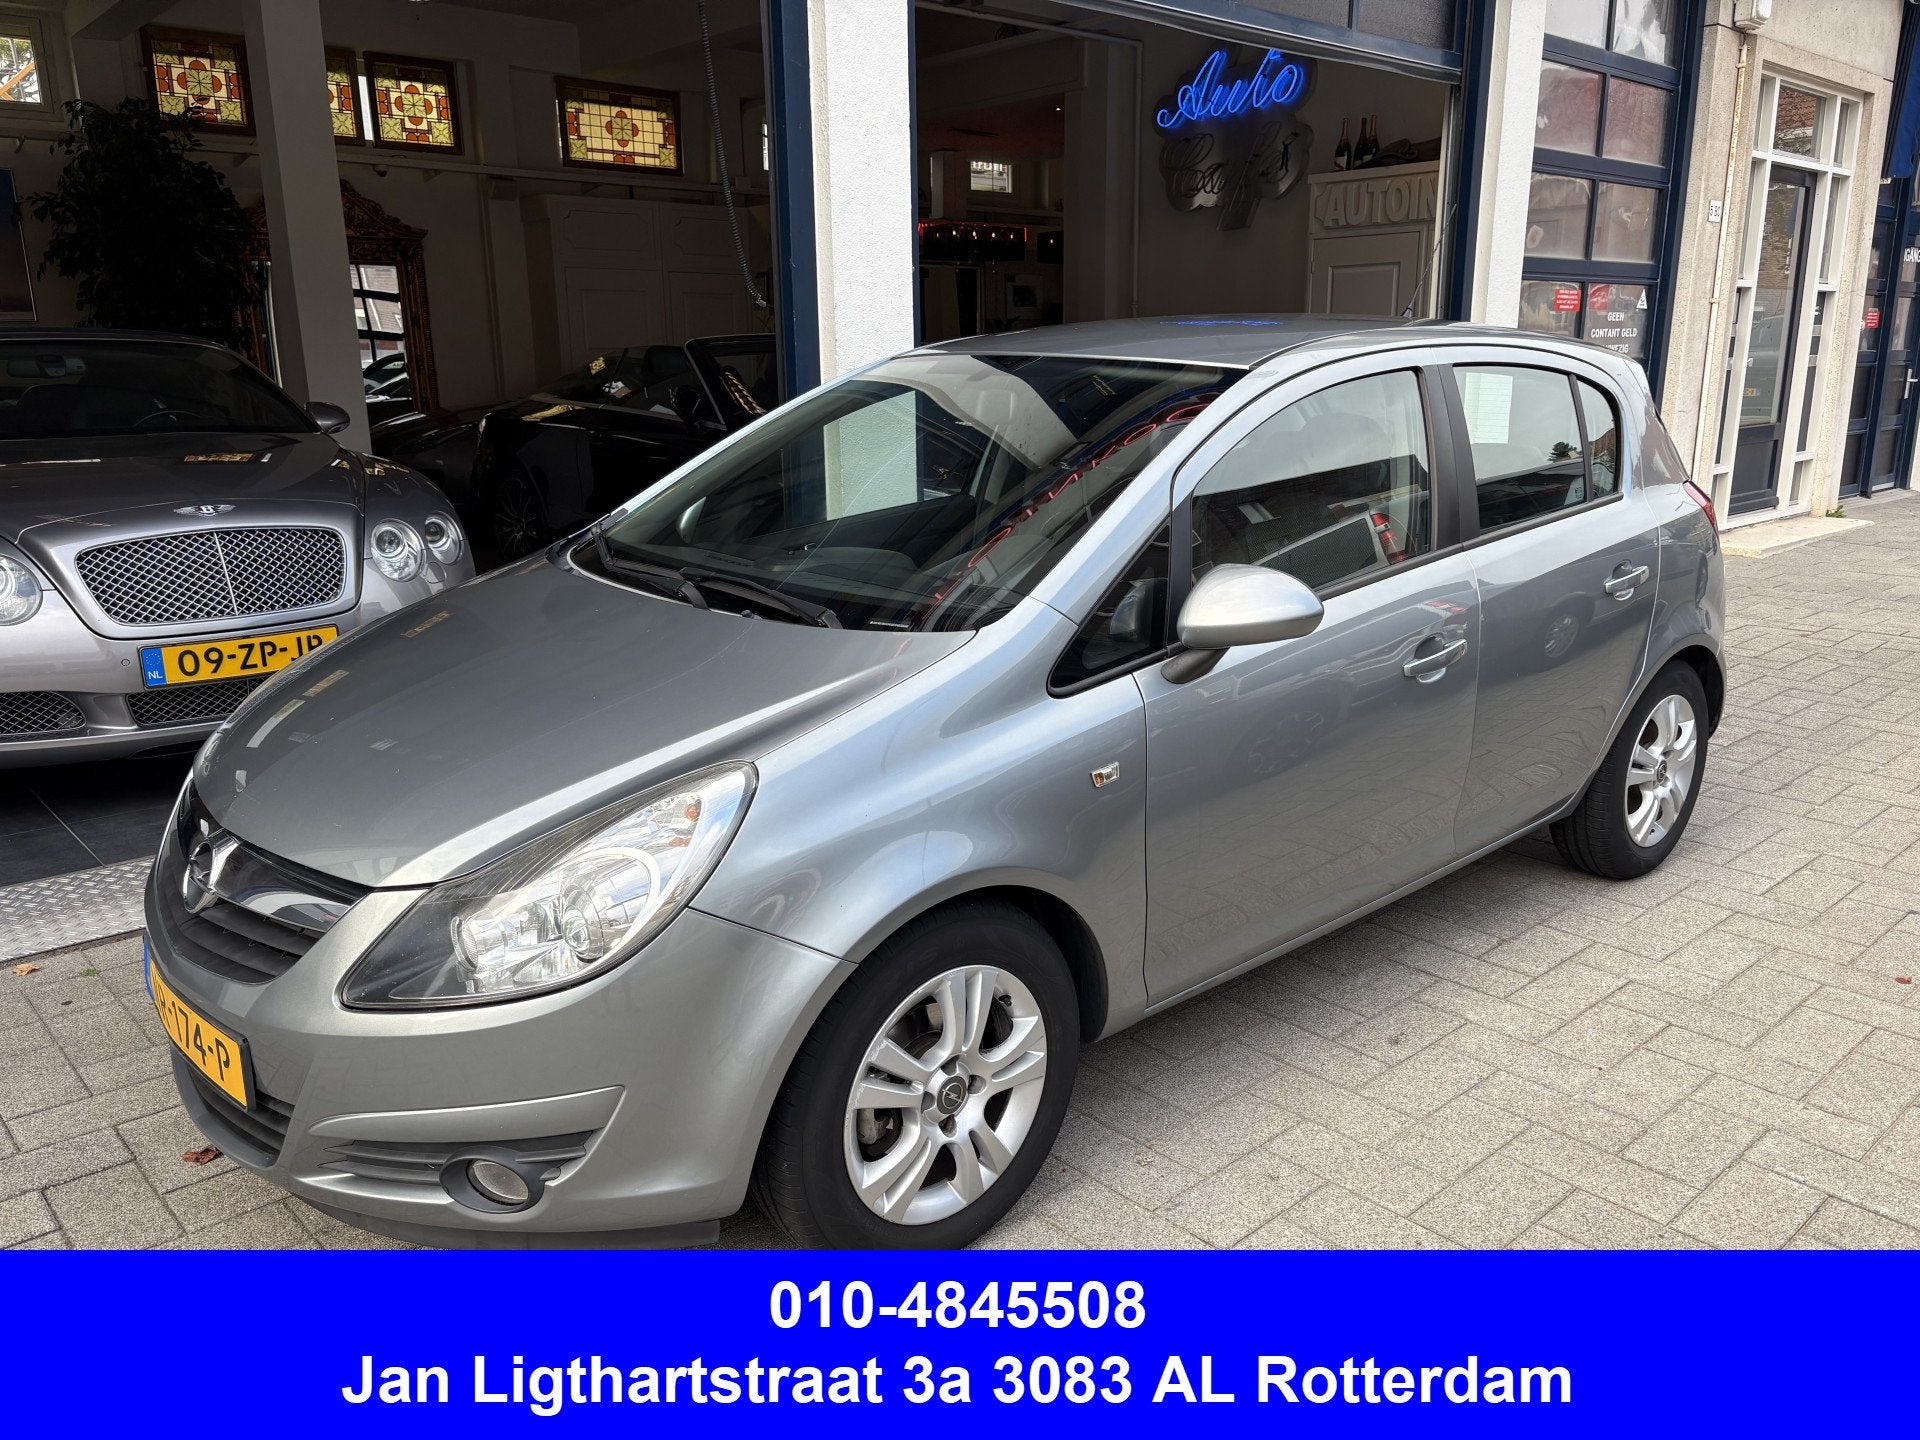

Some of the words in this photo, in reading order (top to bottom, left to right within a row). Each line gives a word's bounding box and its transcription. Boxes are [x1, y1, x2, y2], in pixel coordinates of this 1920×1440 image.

[1156, 48, 1301, 128] Auto
[1607, 312, 1625, 322] GEEN
[1590, 329, 1620, 339] CONTANT
[1621, 328, 1638, 338] GELD
[148, 670, 164, 680] NL
